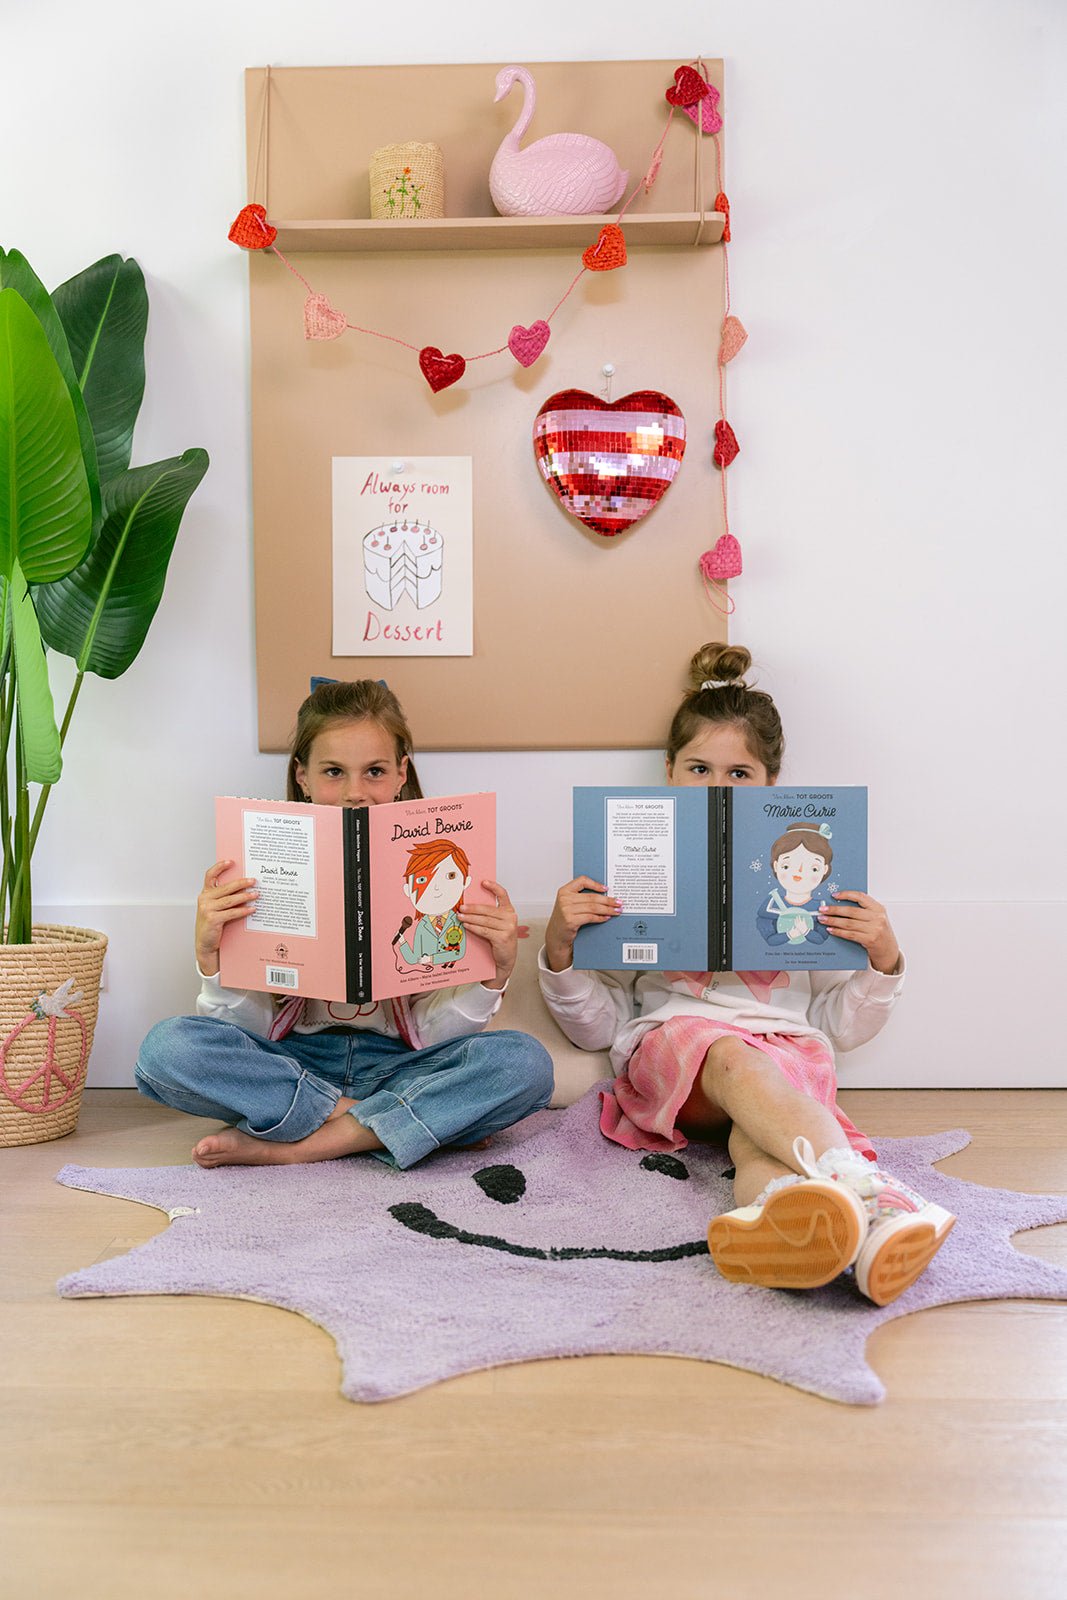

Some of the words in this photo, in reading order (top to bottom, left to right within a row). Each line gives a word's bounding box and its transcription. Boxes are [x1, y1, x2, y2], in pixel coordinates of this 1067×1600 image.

[360, 471, 415, 501] Always
[421, 481, 450, 495] room
[388, 496, 409, 514] for
[363, 611, 443, 642] Dessert
[427, 806, 438, 814] TOT
[439, 803, 463, 812] GROOTS
[763, 803, 802, 818] Marie
[803, 803, 837, 818] Curie
[391, 821, 430, 842] David
[435, 817, 474, 835] Bowie
[260, 865, 279, 875] David
